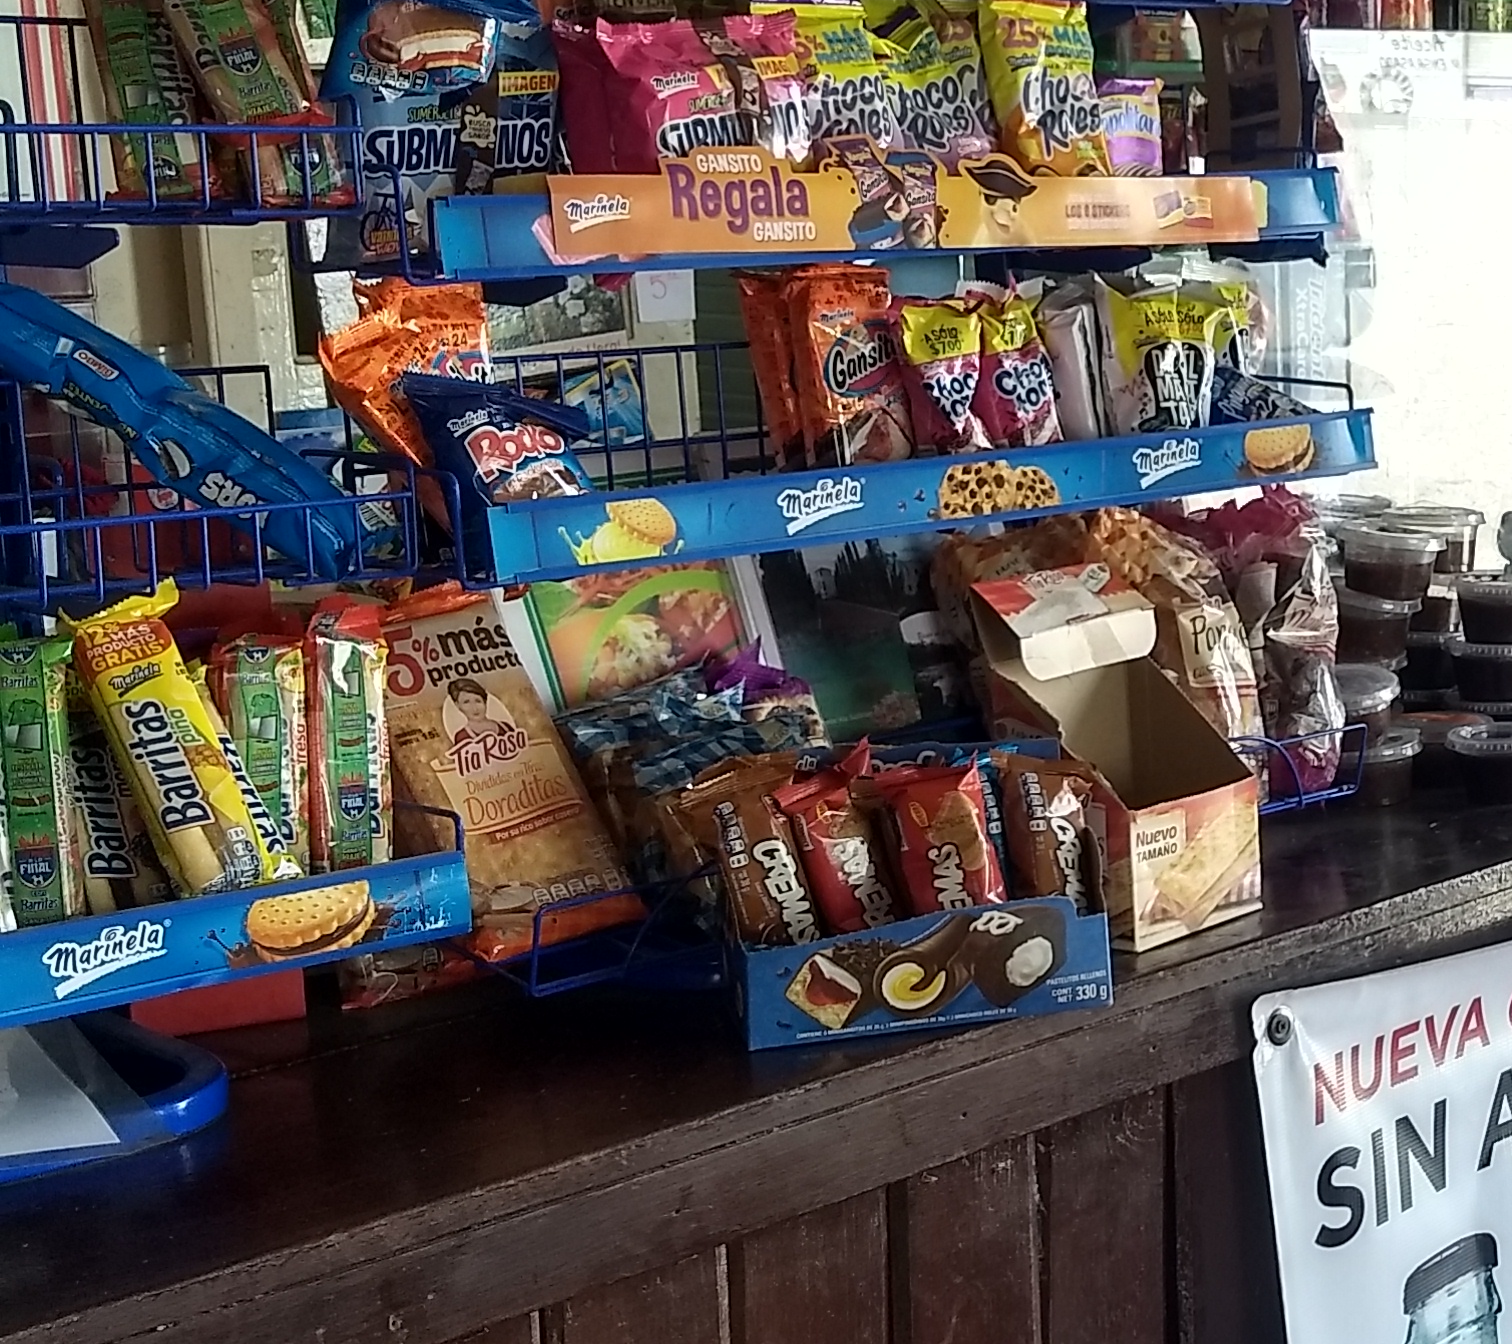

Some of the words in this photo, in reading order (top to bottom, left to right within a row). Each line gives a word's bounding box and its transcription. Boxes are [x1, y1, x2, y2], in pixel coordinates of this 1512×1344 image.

[226, 50, 258, 67] FINAL
[501, 73, 557, 93] IMAGEN
[652, 72, 698, 90] Marinela
[696, 153, 763, 174] GANSITO
[566, 194, 628, 221] Marinela
[665, 162, 810, 235] Regala
[753, 221, 817, 242] GANSITO
[77, 350, 114, 378] BIMBO
[464, 424, 565, 484] Rocko
[1135, 439, 1198, 471] Marinela
[779, 478, 859, 516] Marinela
[76, 621, 120, 649] 12%
[110, 623, 151, 642] MÁS
[86, 633, 156, 660] PRODUCTO
[439, 616, 514, 657] más
[91, 642, 163, 672] GRATIS
[1, 675, 40, 689] Barritas
[109, 661, 161, 691] Marinela
[169, 707, 203, 747] piña
[125, 699, 213, 833] Barritas
[447, 738, 482, 777] Tía
[480, 729, 528, 766] Rosa
[72, 747, 138, 878] Barritas
[463, 774, 568, 827] Doraditas
[1135, 823, 1178, 848] Nuevo
[1135, 840, 1178, 864] TAMAÑO
[19, 859, 51, 875] FINAL
[21, 897, 59, 914] Barritas
[752, 838, 821, 945] CREMAS
[48, 927, 166, 974] Marinela
[1051, 985, 1073, 997] CONT
[1075, 984, 1098, 1001] 330
[1312, 996, 1490, 1127] NUEVA
[1313, 1097, 1448, 1251] SIN
